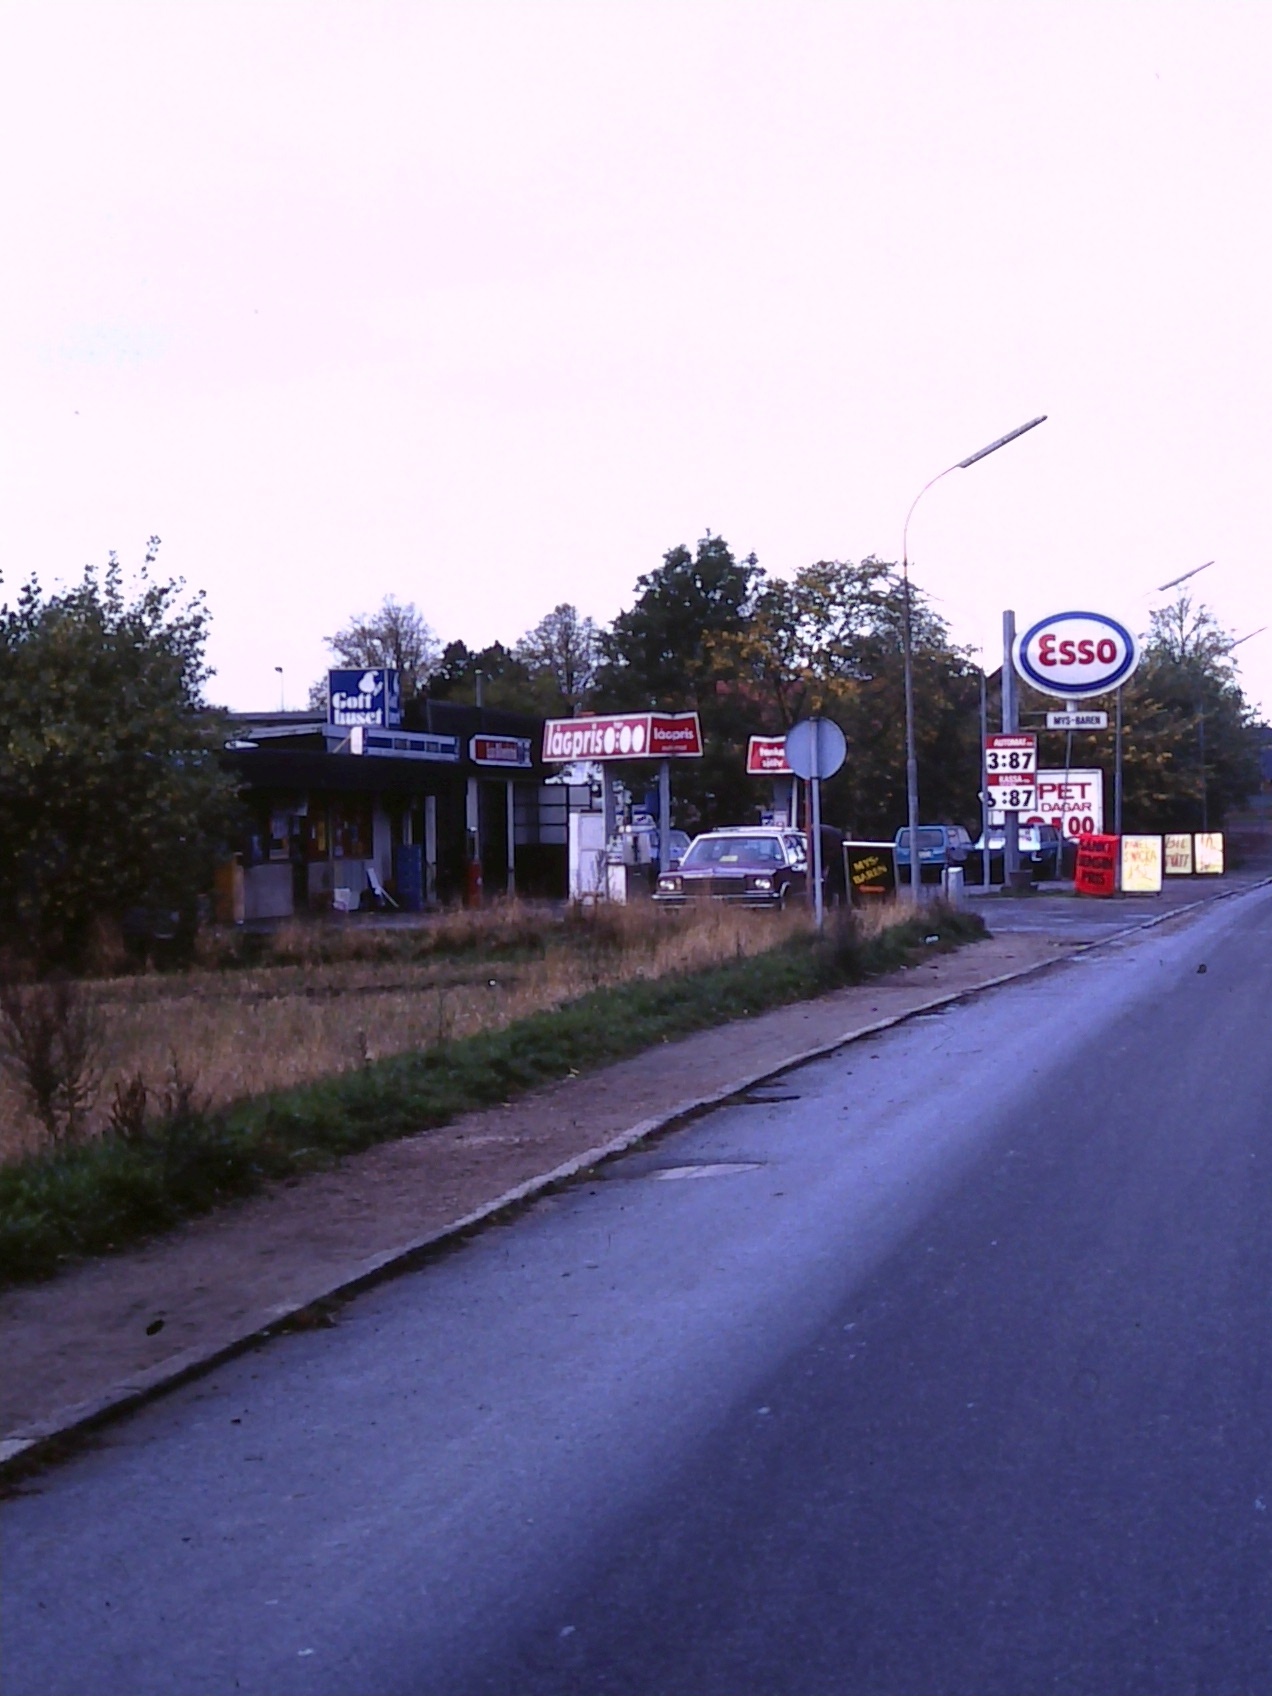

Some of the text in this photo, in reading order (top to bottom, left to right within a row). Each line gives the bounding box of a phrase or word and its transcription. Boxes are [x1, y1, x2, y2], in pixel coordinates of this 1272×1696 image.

[332, 691, 372, 710] Gott
[333, 706, 383, 726] huset
[1052, 715, 1102, 726] MYS-BAREN
[987, 751, 1034, 770] 3:87
[1041, 802, 1092, 812] DAGAR
